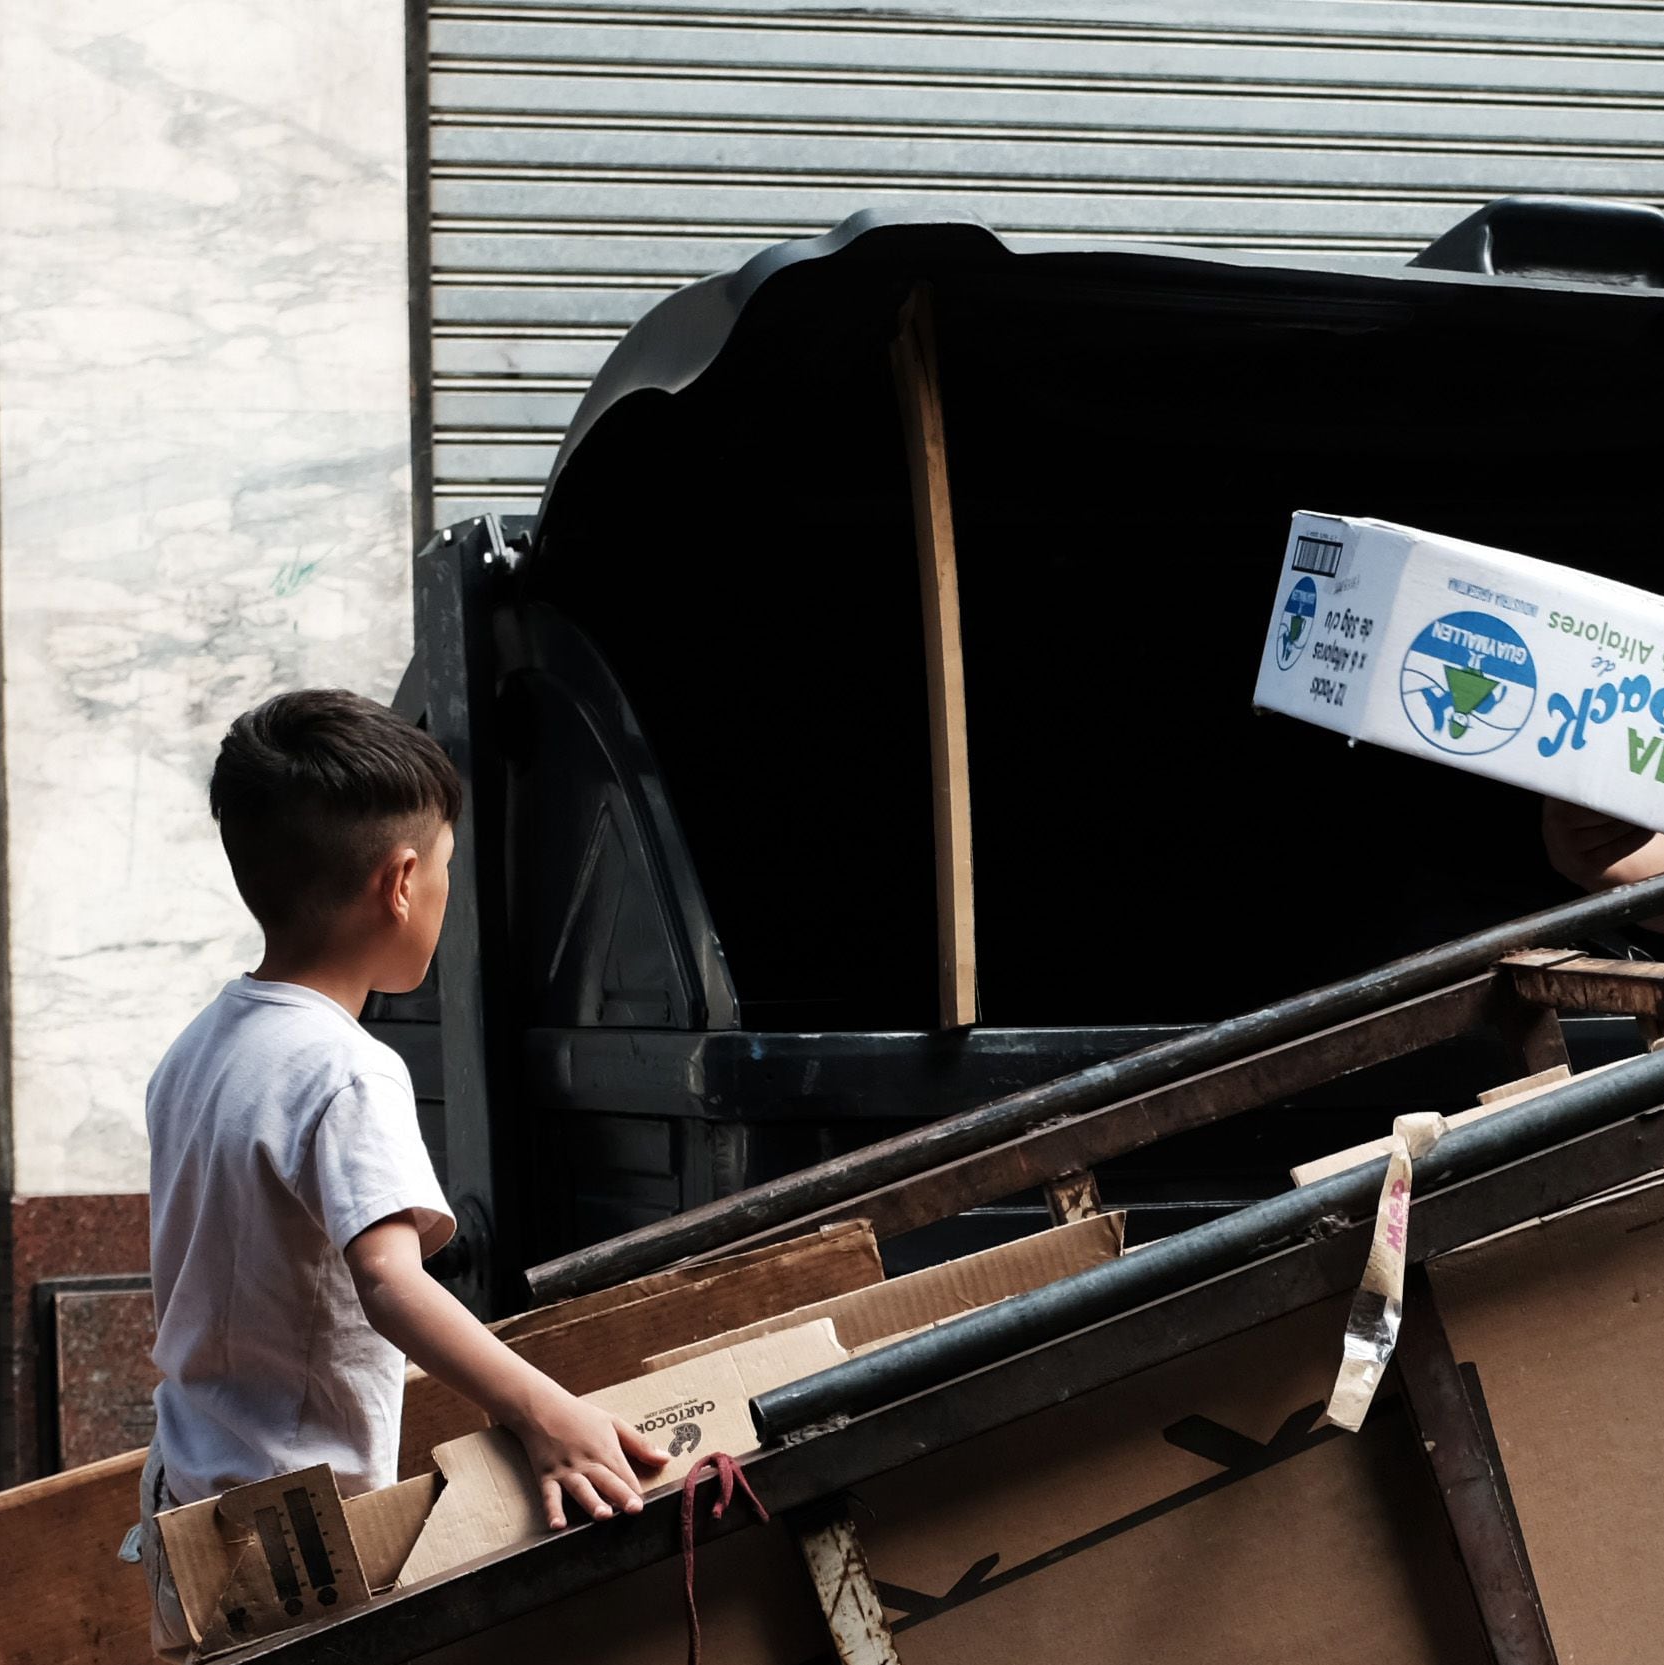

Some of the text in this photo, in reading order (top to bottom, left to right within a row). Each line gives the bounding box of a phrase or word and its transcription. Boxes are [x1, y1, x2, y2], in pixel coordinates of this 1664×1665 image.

[1432, 618, 1530, 664] GUAYMALLEN
[1547, 611, 1654, 664] Alfajores
[1312, 640, 1351, 671] Alfajores
[1591, 656, 1615, 677] de
[1310, 677, 1336, 703] Packs
